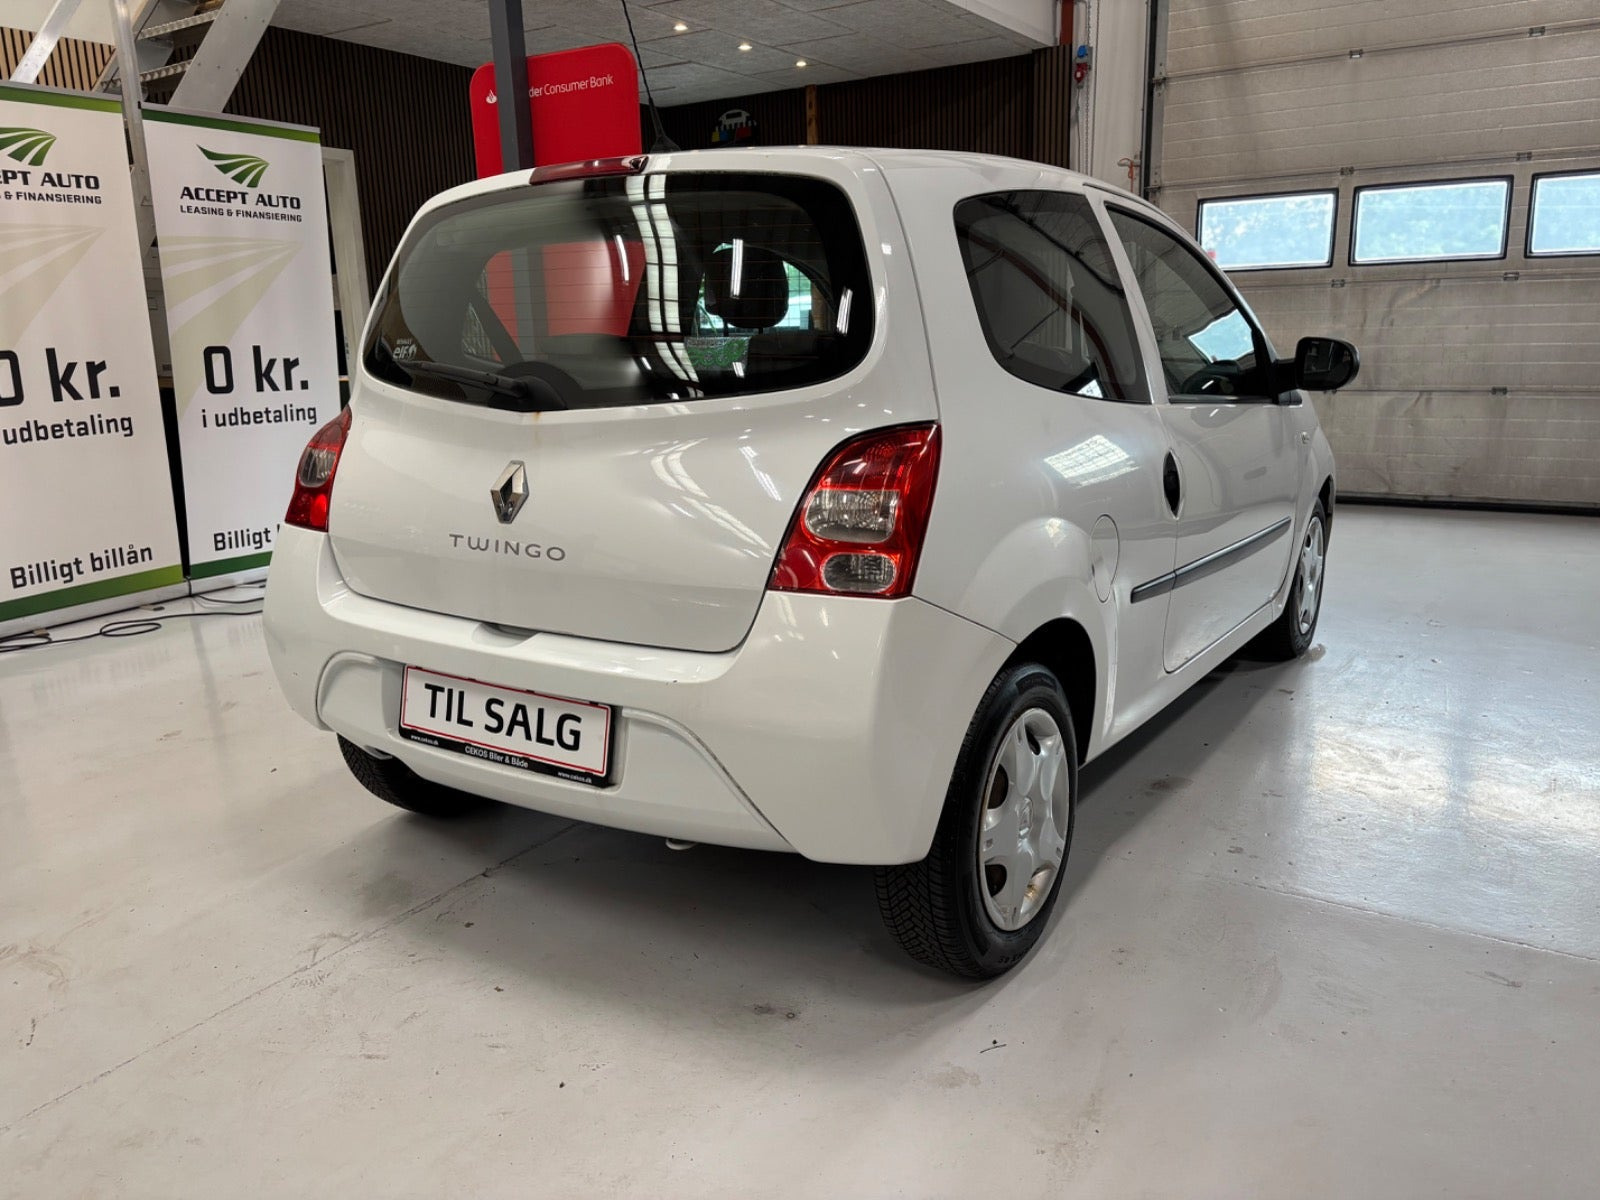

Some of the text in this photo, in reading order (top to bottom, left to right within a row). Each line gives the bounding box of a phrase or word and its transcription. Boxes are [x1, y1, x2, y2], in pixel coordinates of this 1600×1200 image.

[544, 79, 589, 95] Consumer
[590, 74, 614, 88] Bank
[0, 169, 100, 190] PT AUTO
[4, 191, 13, 201] &
[16, 191, 102, 205] FINANSIERING
[180, 186, 301, 209] ACCEPT AUTO
[180, 205, 303, 223] LEASING & FINANSIERING
[45, 347, 121, 402] kr.
[203, 345, 309, 395] 0 kr.
[201, 404, 317, 428] i udbetaling
[2, 413, 134, 445] udbetaling
[213, 528, 272, 551] Billigt
[448, 533, 566, 562] TWINGO
[9, 544, 153, 590] Billigt billån
[424, 683, 582, 752] TIL SALG
[464, 745, 488, 758] CEKOS
[489, 751, 504, 762] Biler
